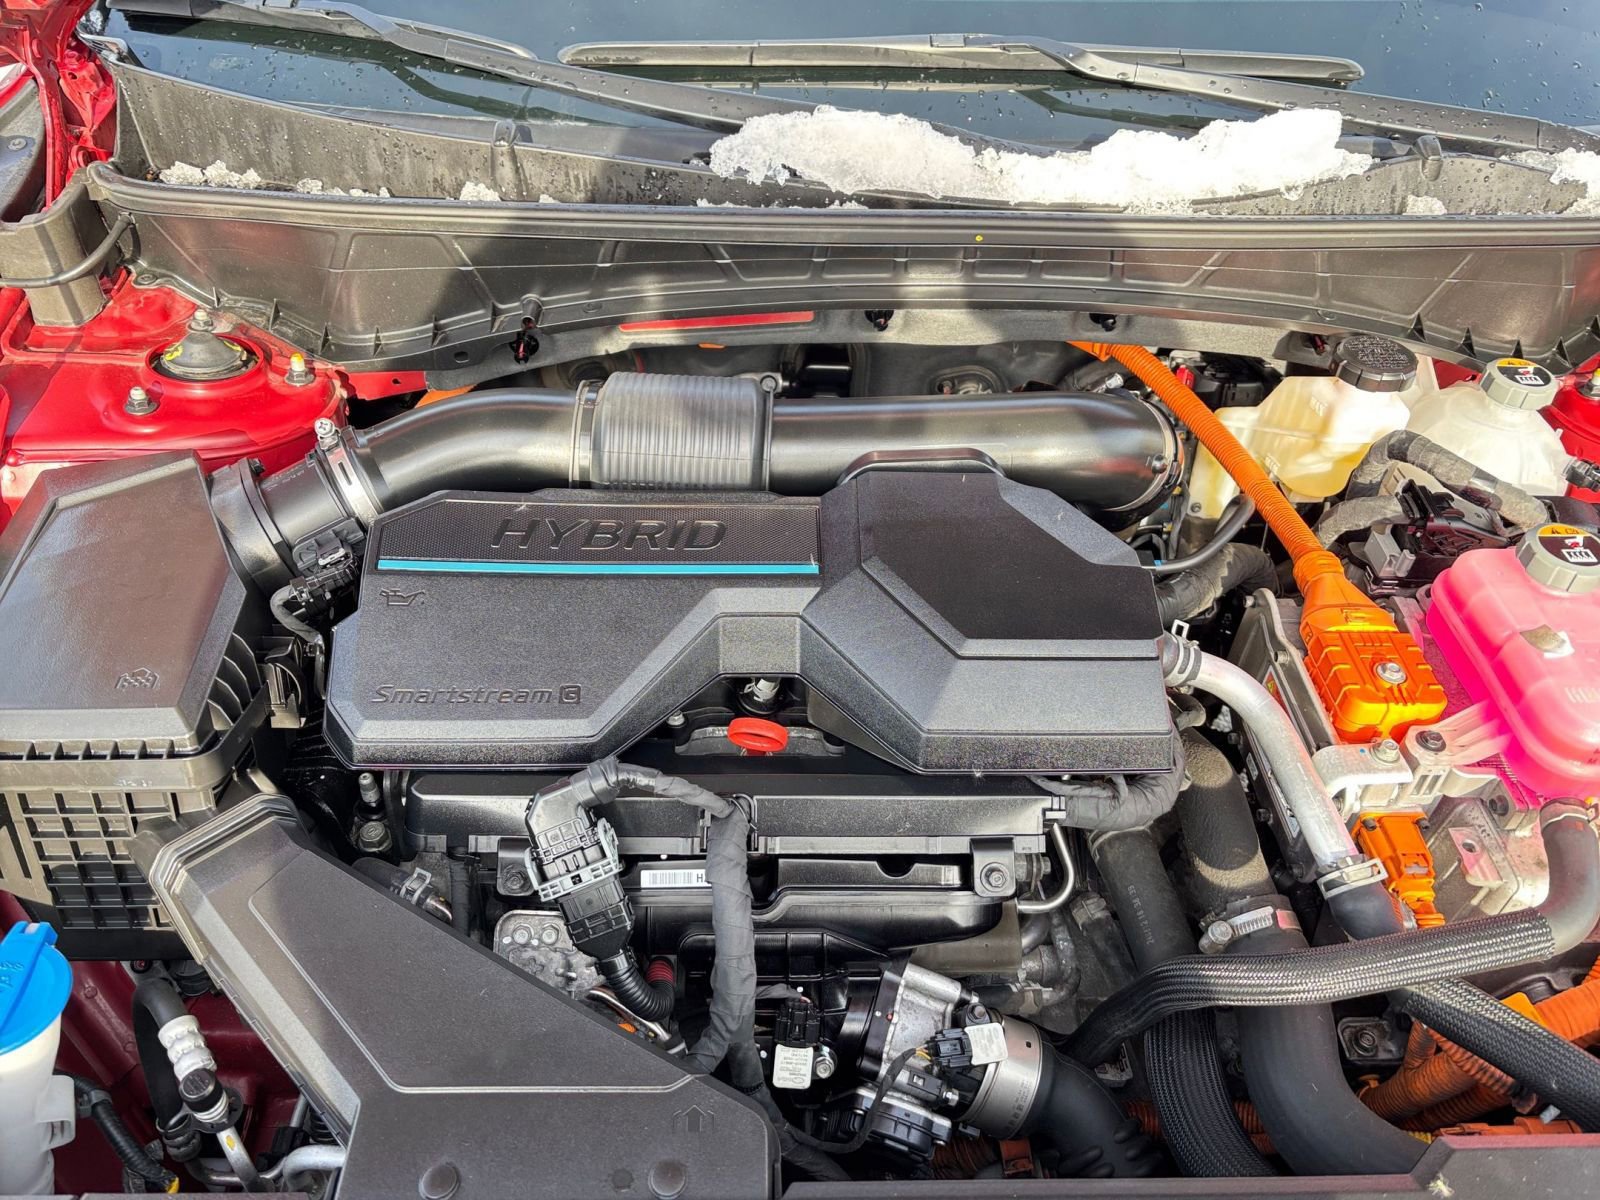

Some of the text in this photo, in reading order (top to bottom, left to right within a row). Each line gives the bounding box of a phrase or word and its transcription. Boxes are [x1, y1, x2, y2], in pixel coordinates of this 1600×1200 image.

[490, 517, 728, 550] HYBRID
[371, 684, 580, 704] Smartstream G
